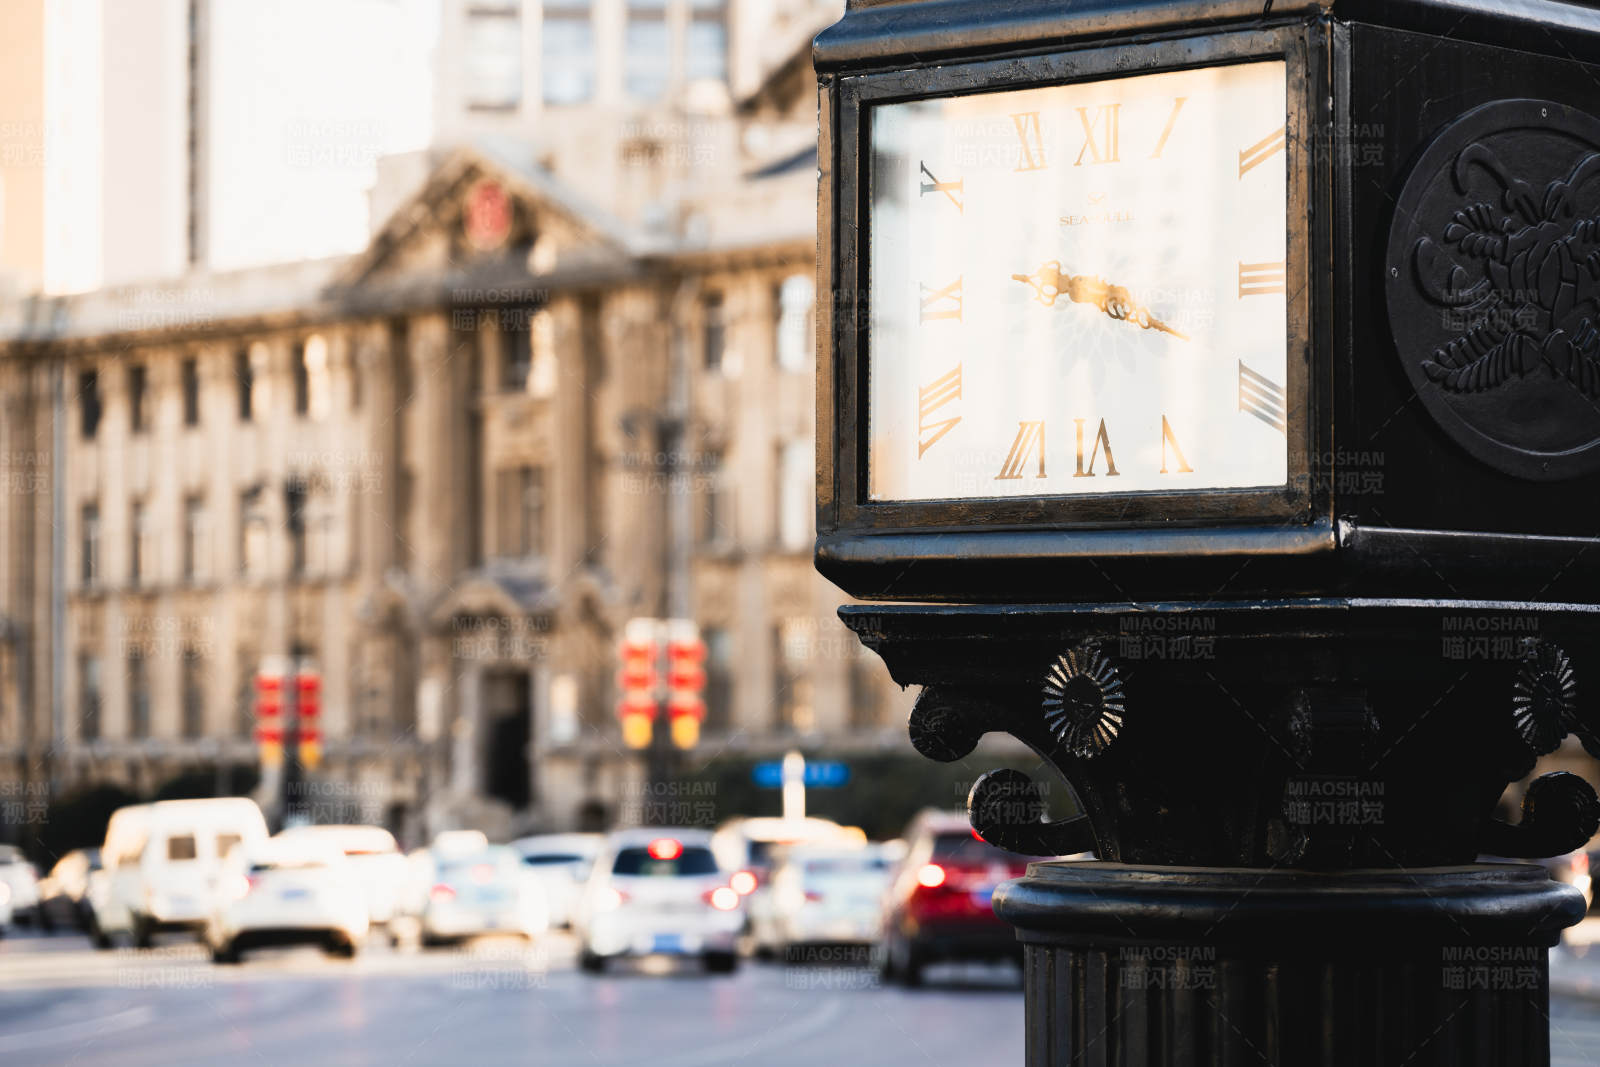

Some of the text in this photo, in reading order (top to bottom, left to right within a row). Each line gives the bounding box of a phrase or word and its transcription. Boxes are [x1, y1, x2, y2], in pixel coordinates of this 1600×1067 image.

[1008, 111, 1048, 172] XI
[1074, 103, 1122, 166] XII
[1239, 122, 1286, 181] II
[920, 160, 963, 216] X
[920, 275, 962, 326] IX
[1239, 259, 1286, 300] III
[919, 362, 962, 460] VIII
[1239, 358, 1286, 438] IIII
[994, 420, 1047, 480] VII
[1073, 417, 1120, 477] VI
[1160, 414, 1194, 474] V
